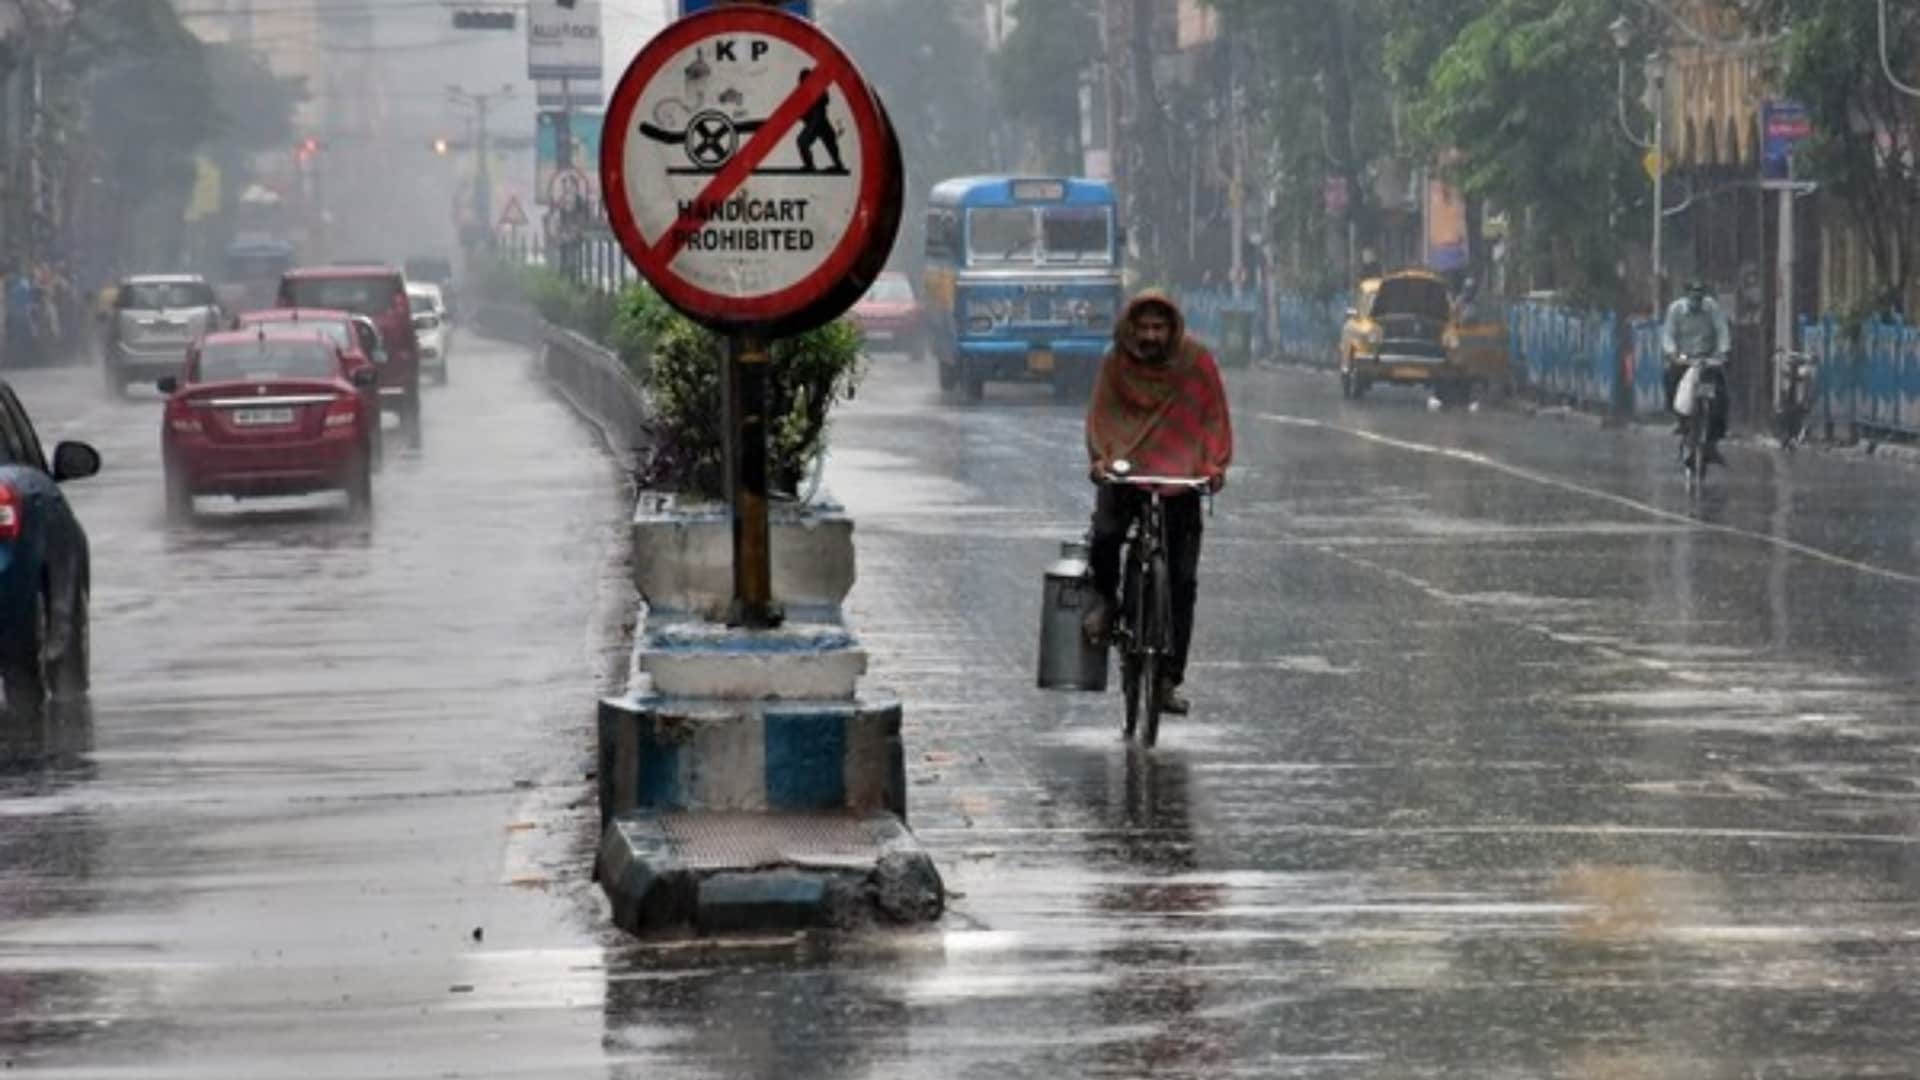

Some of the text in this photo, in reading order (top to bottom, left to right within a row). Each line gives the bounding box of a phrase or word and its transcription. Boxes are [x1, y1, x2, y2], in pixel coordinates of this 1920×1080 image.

[716, 40, 769, 62] K P
[677, 199, 809, 222] HAND CART
[674, 229, 814, 251] PROHIBITED
